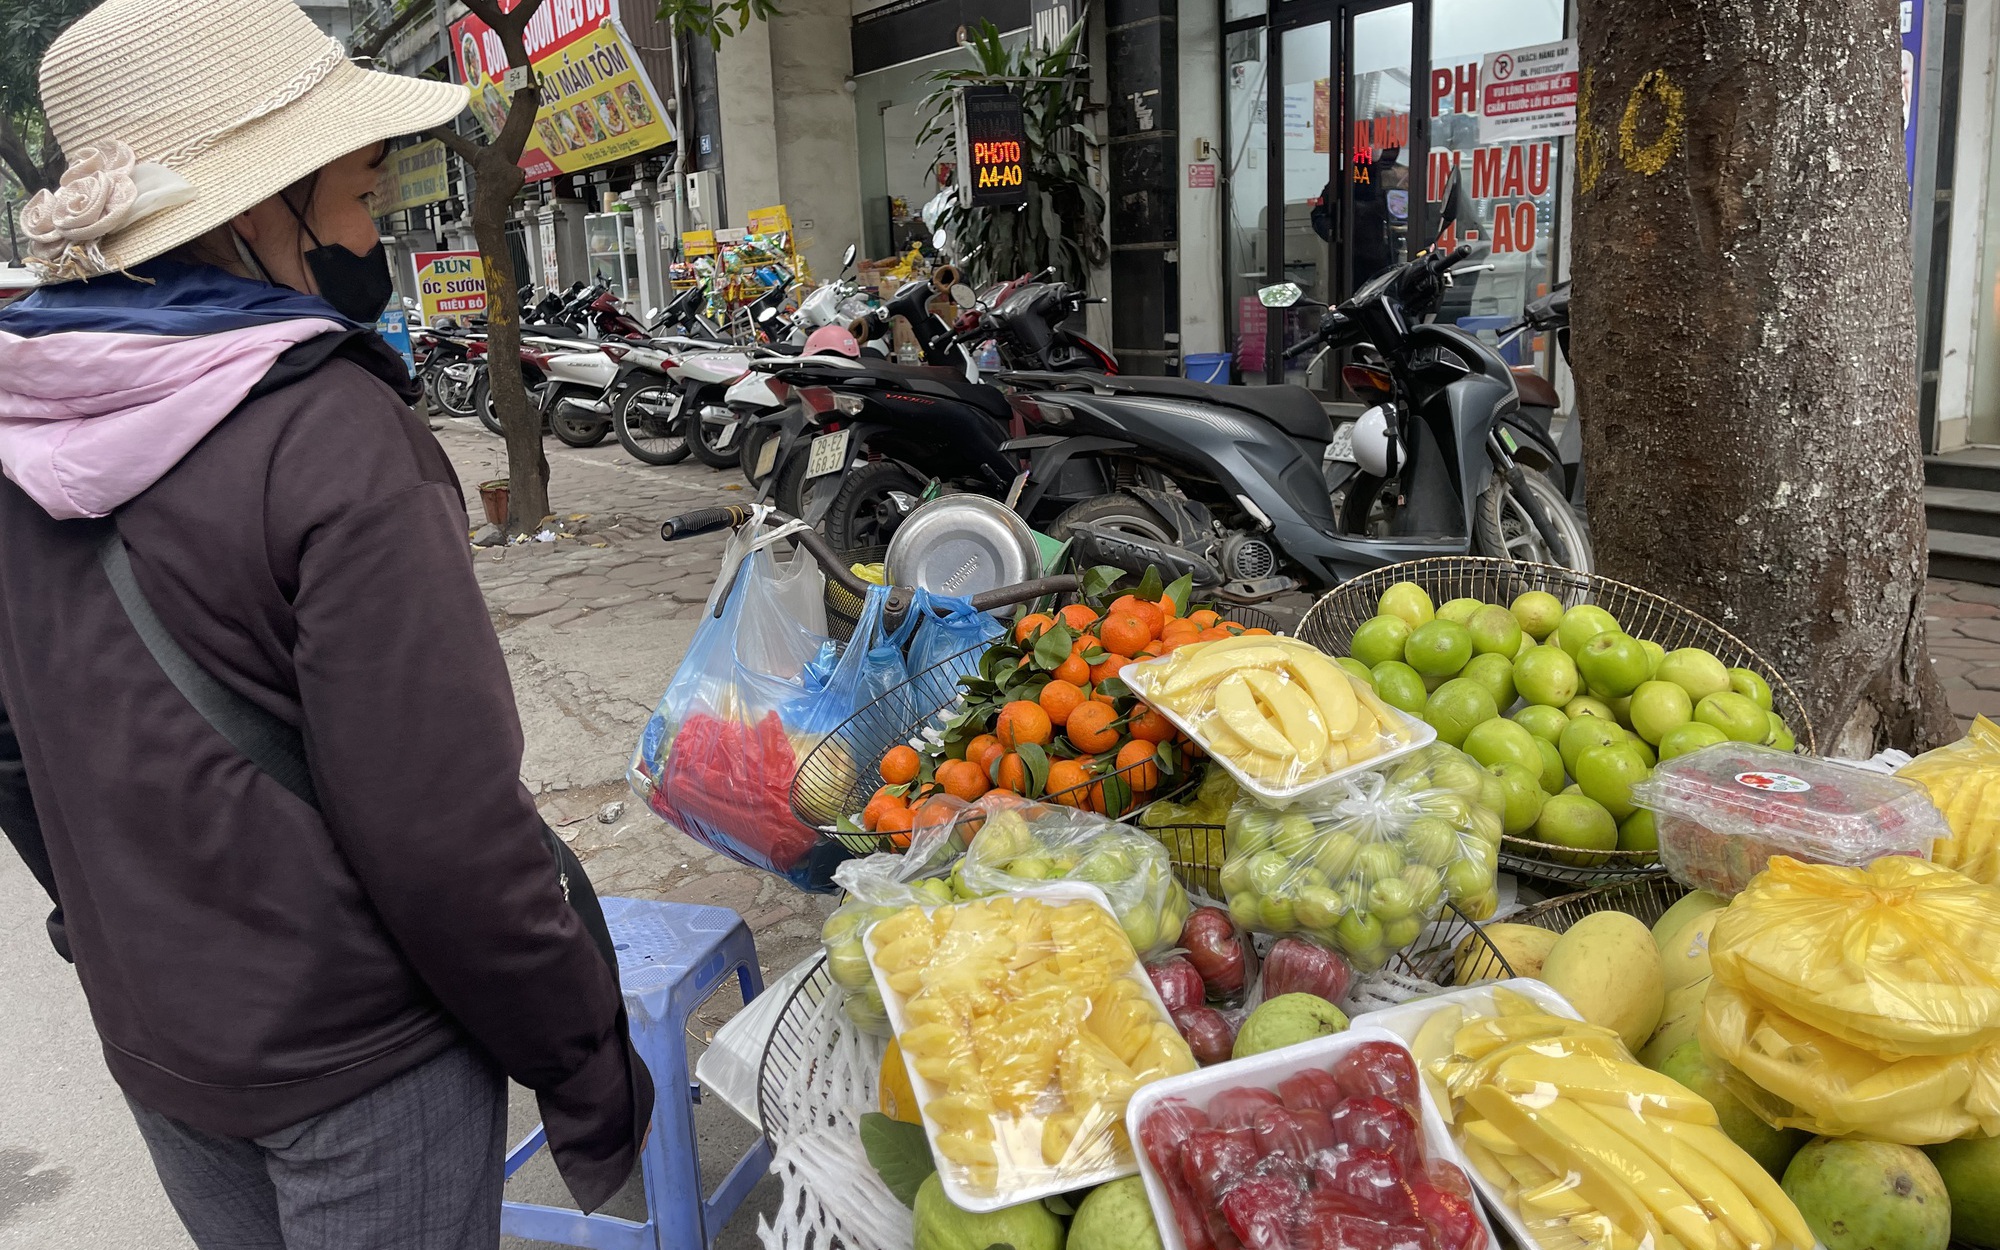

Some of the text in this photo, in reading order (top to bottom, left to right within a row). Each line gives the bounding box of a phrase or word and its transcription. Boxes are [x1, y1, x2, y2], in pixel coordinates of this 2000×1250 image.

[556, 52, 595, 96] MẮM
[587, 42, 629, 82] TÔM
[1431, 63, 1482, 118] PH
[1374, 109, 1408, 150] MÀU
[974, 141, 1020, 165] PHOTO
[433, 257, 471, 274] BÚN
[423, 277, 485, 294] ỐC SƯỜN
[440, 299, 465, 310] RIÊU
[816, 434, 842, 456] 29-E2
[810, 451, 842, 474] 468.37
